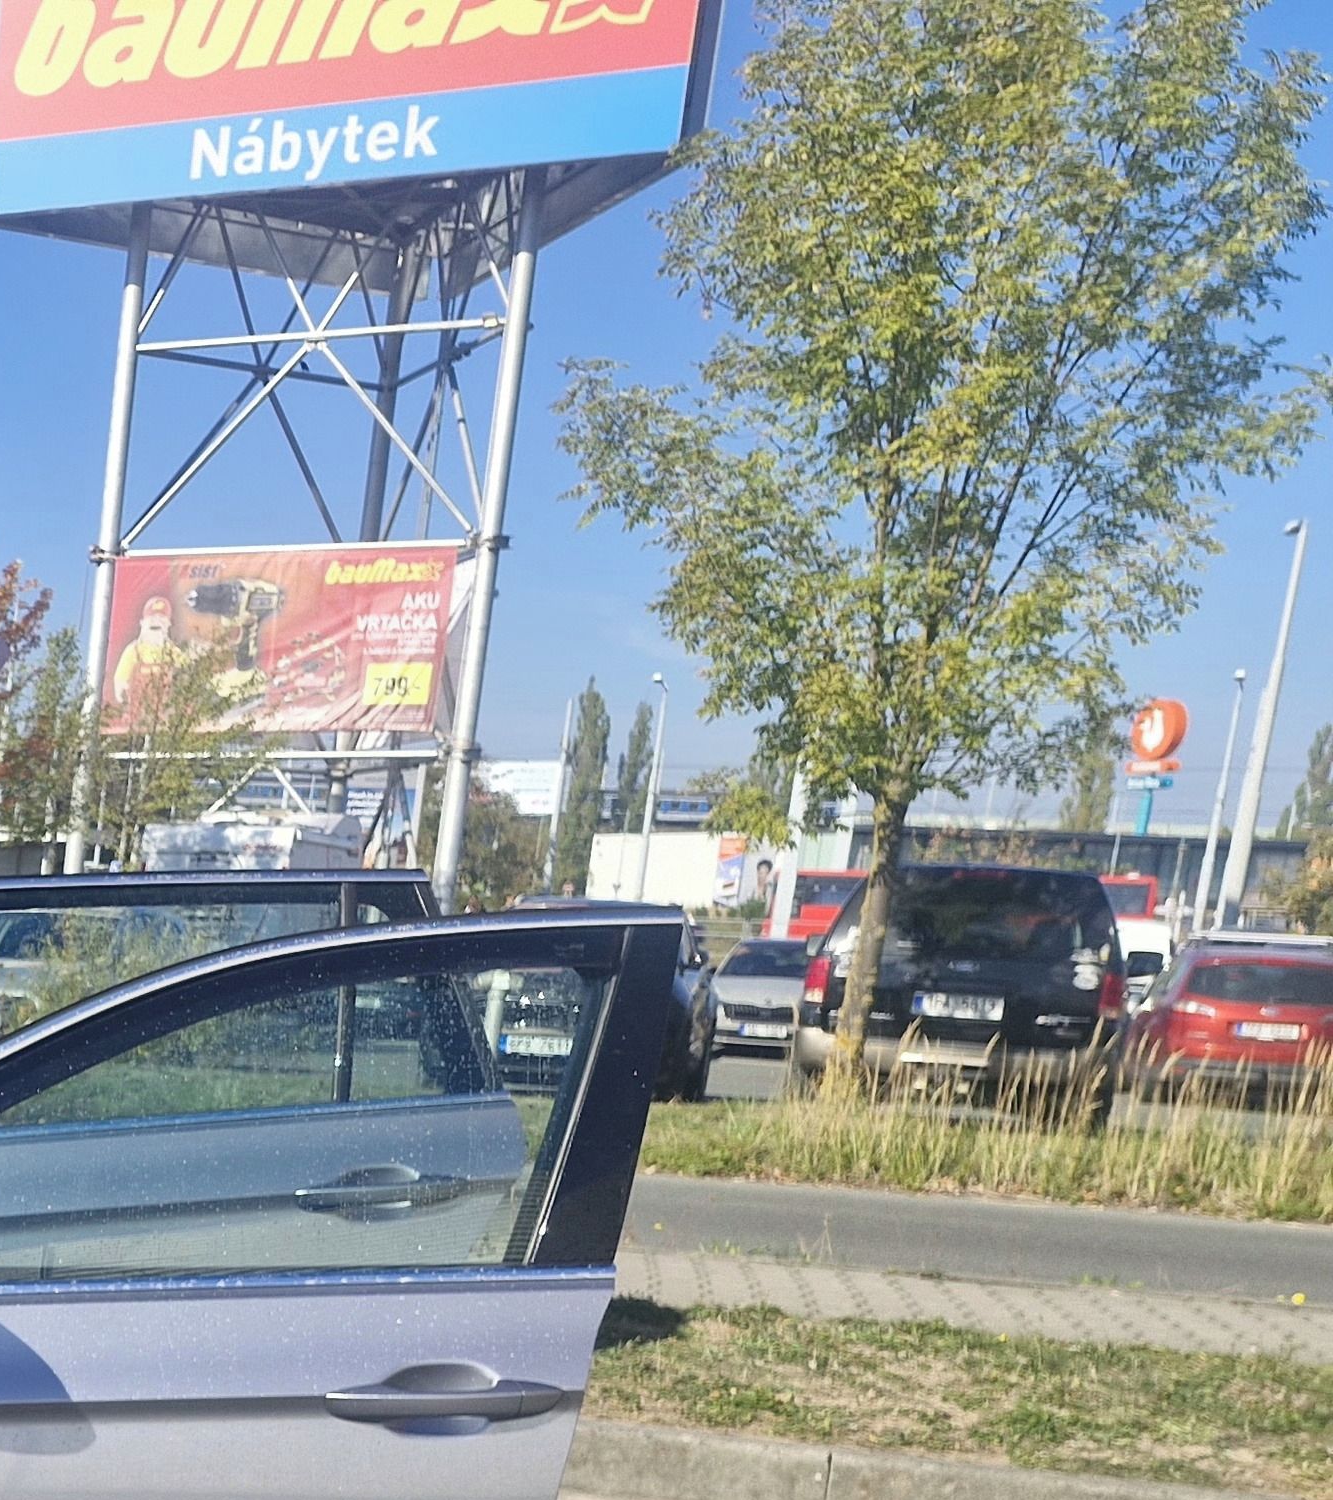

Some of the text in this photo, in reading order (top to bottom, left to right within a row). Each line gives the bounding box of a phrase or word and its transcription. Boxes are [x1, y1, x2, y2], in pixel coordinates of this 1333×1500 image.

[189, 105, 439, 181] Nábytek
[401, 591, 441, 609] AKU
[356, 610, 438, 631] VRTAČKA
